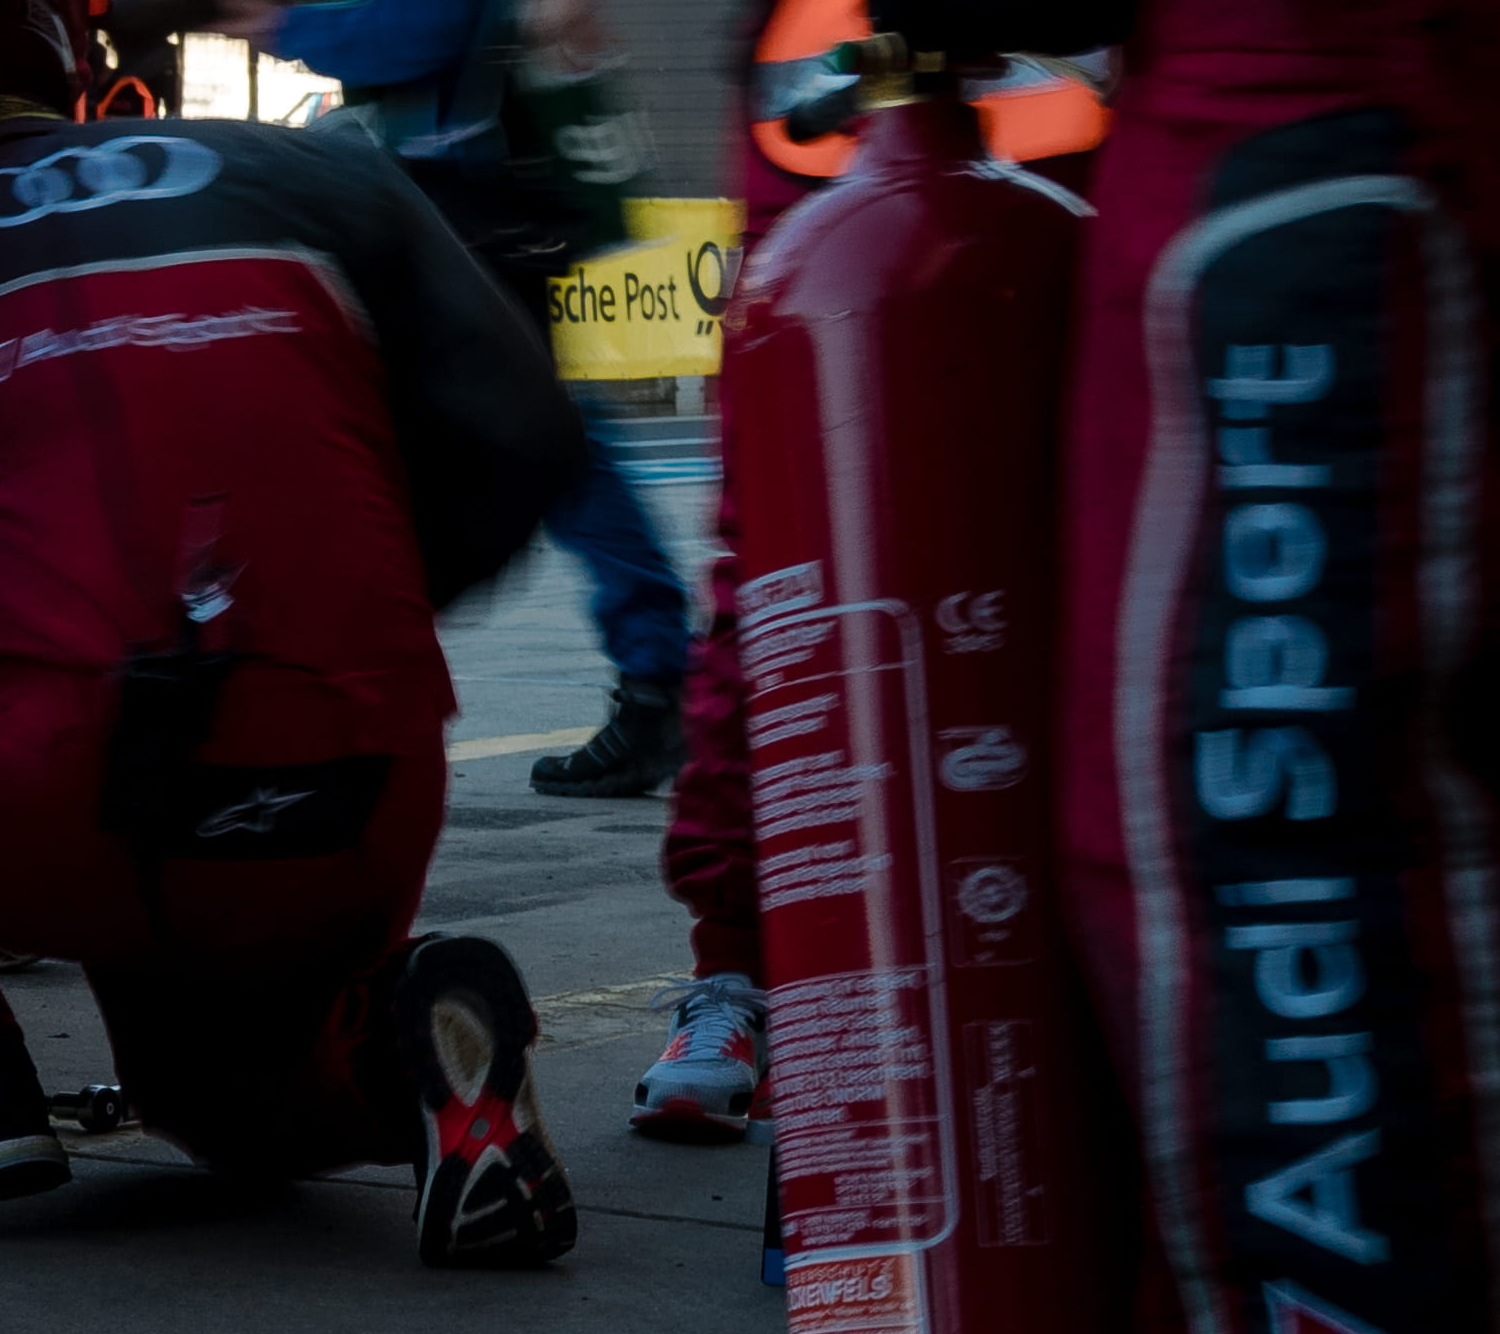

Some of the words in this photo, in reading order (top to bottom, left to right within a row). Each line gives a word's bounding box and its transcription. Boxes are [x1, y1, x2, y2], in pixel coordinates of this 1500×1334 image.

[624, 272, 681, 322] Post
[1192, 341, 1358, 825] Sport
[1213, 875, 1394, 1267] Audi
